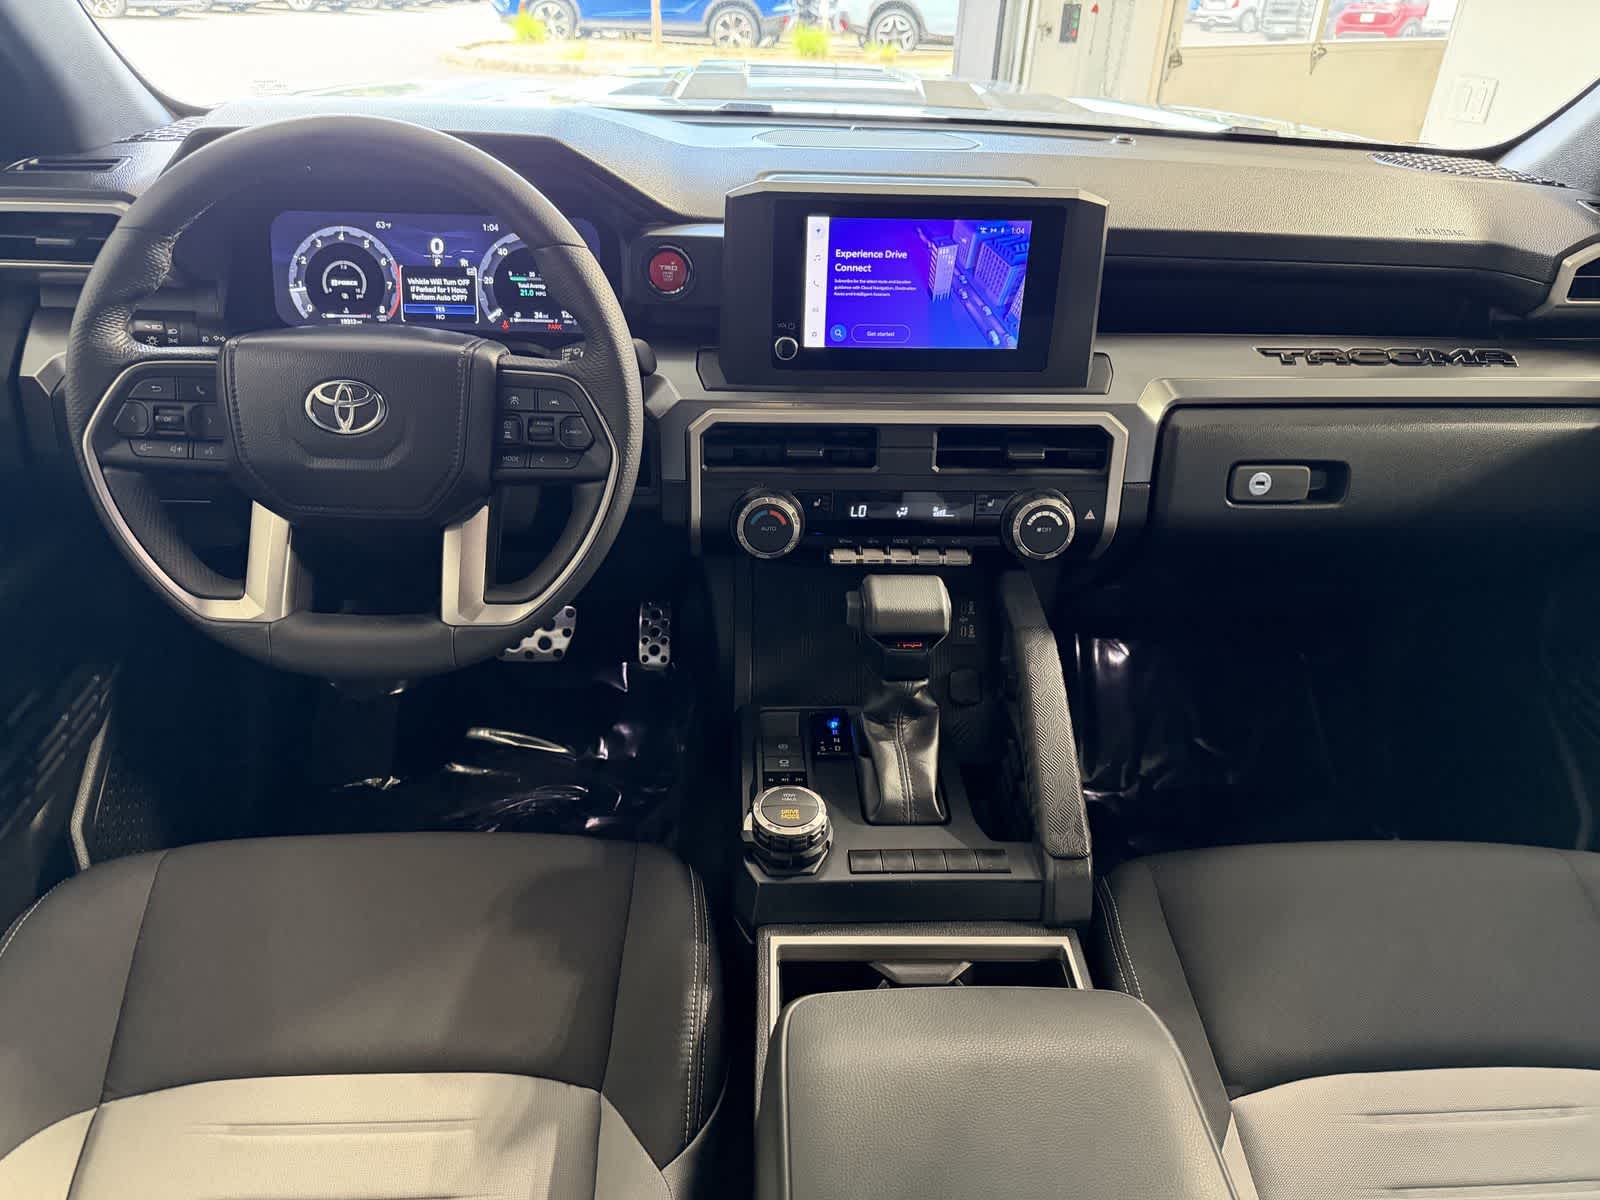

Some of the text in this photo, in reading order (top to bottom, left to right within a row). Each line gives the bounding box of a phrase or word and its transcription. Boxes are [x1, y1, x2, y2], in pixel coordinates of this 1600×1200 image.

[483, 224, 499, 232] 1:04
[316, 238, 322, 248] 3
[364, 240, 370, 249] 5
[430, 238, 444, 254] 0
[835, 249, 908, 260] Experience Drive
[300, 256, 306, 265] 2
[380, 258, 386, 266] 6
[434, 259, 441, 267] P
[834, 263, 872, 272] Connect
[386, 281, 392, 290] 7
[307, 304, 312, 312] 0
[380, 306, 386, 314] 8
[1252, 346, 1519, 368] TACOMA
